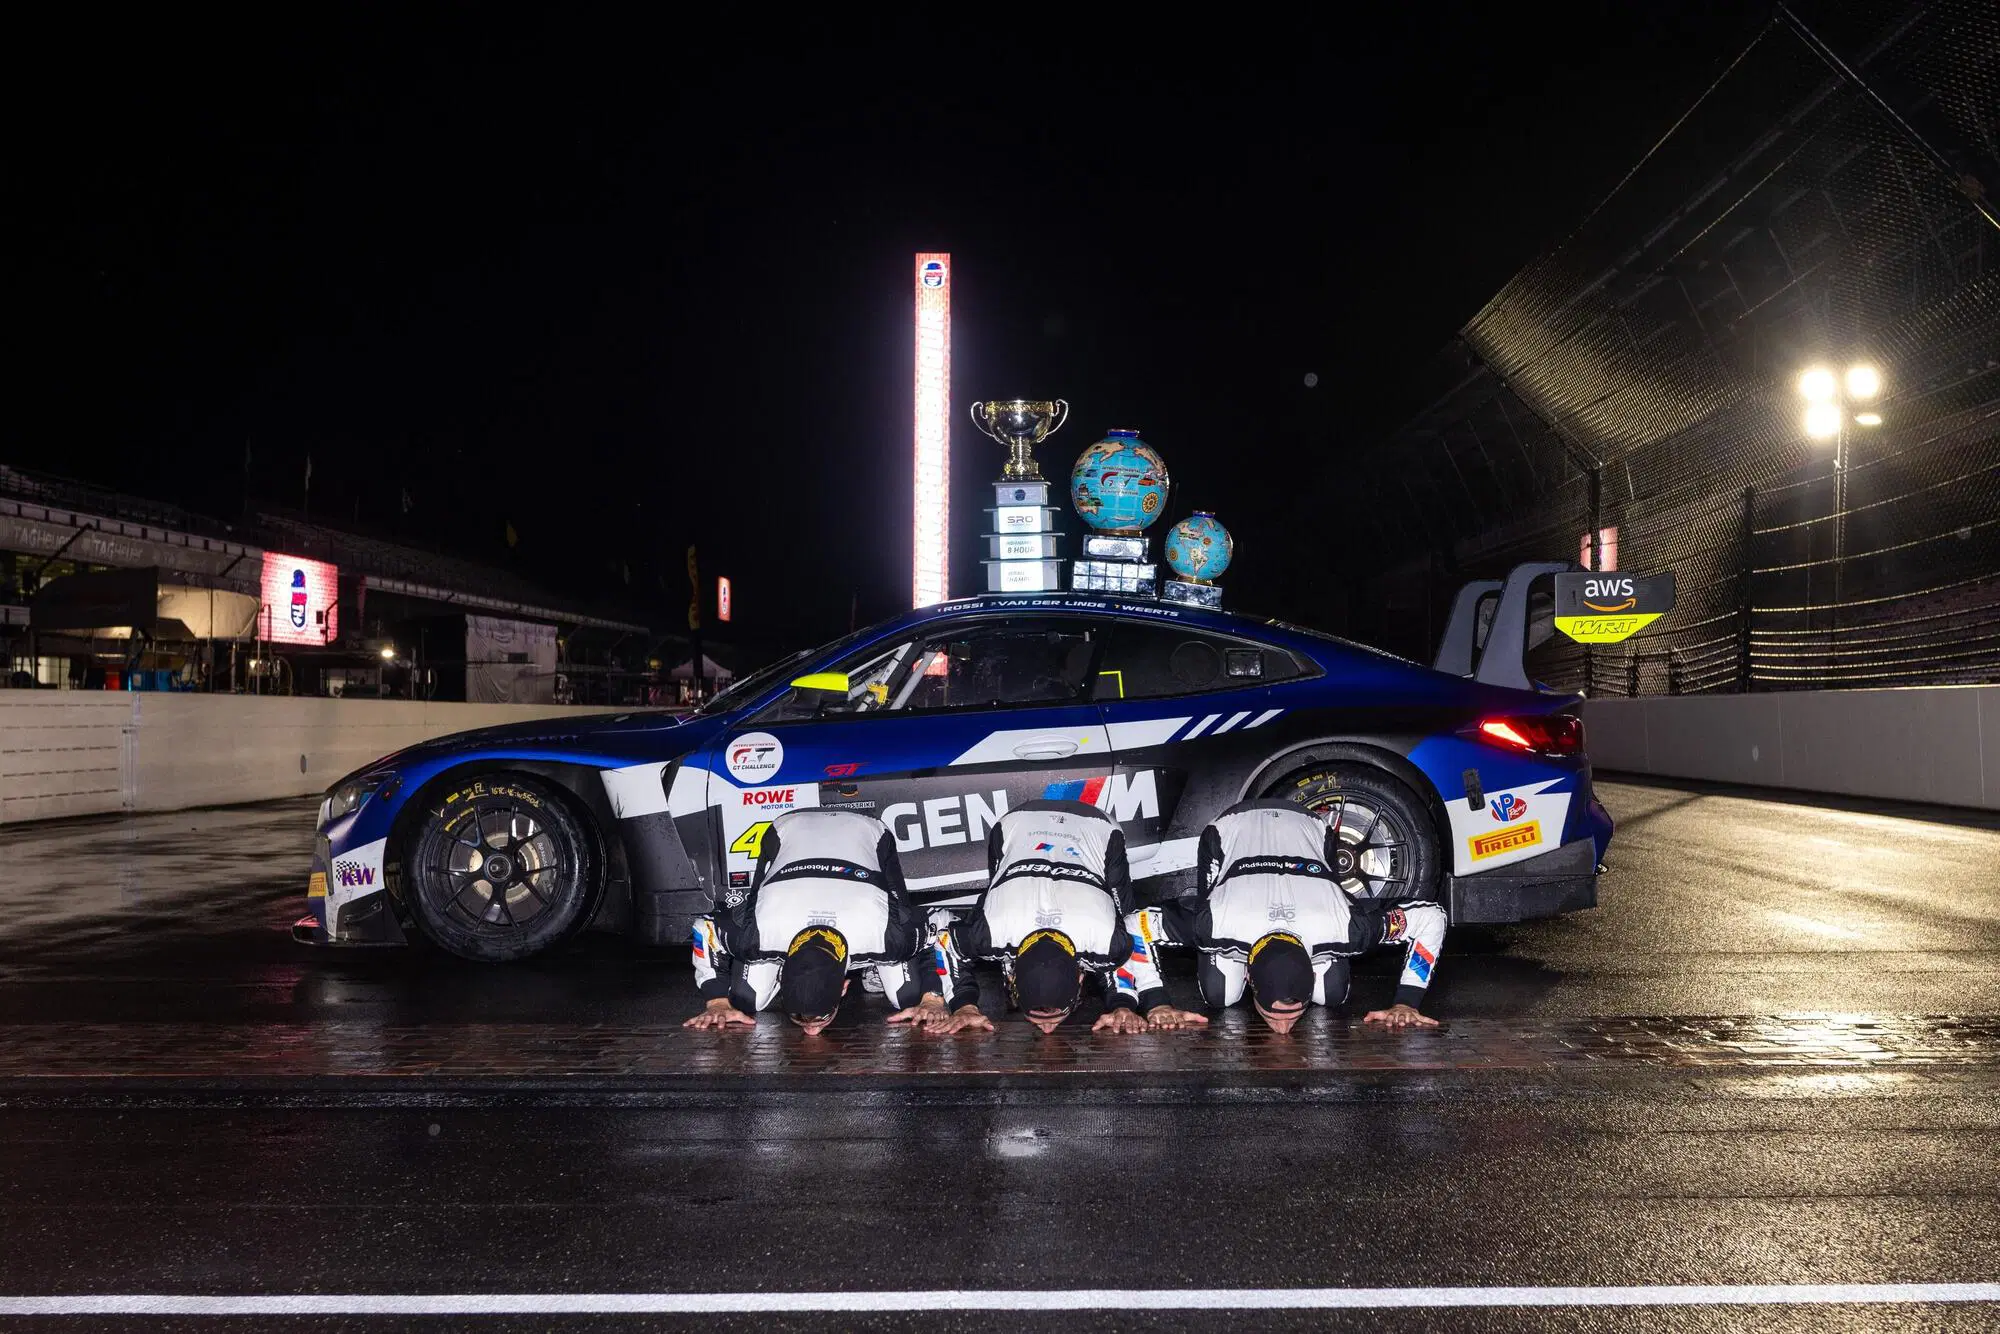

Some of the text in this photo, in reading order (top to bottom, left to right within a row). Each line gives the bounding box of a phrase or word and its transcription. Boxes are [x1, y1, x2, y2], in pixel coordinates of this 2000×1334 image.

[1007, 516, 1033, 524] SRO
[1584, 578, 1634, 598] aws
[943, 602, 984, 613] ROSSI
[1064, 601, 1107, 609] LINDE
[1121, 605, 1180, 617] WEERTS
[1571, 618, 1638, 635] WRT
[741, 763, 776, 771] CHALLENGE
[742, 789, 795, 806] ROWE
[1095, 769, 1160, 823] M
[1490, 793, 1515, 822] VP
[880, 789, 1010, 853] GEN
[1474, 825, 1536, 856] PIRELLI
[780, 864, 829, 875] Motorsport
[1238, 860, 1284, 871] Motorsport
[341, 867, 376, 887] KW
[1268, 908, 1296, 920] OMP
